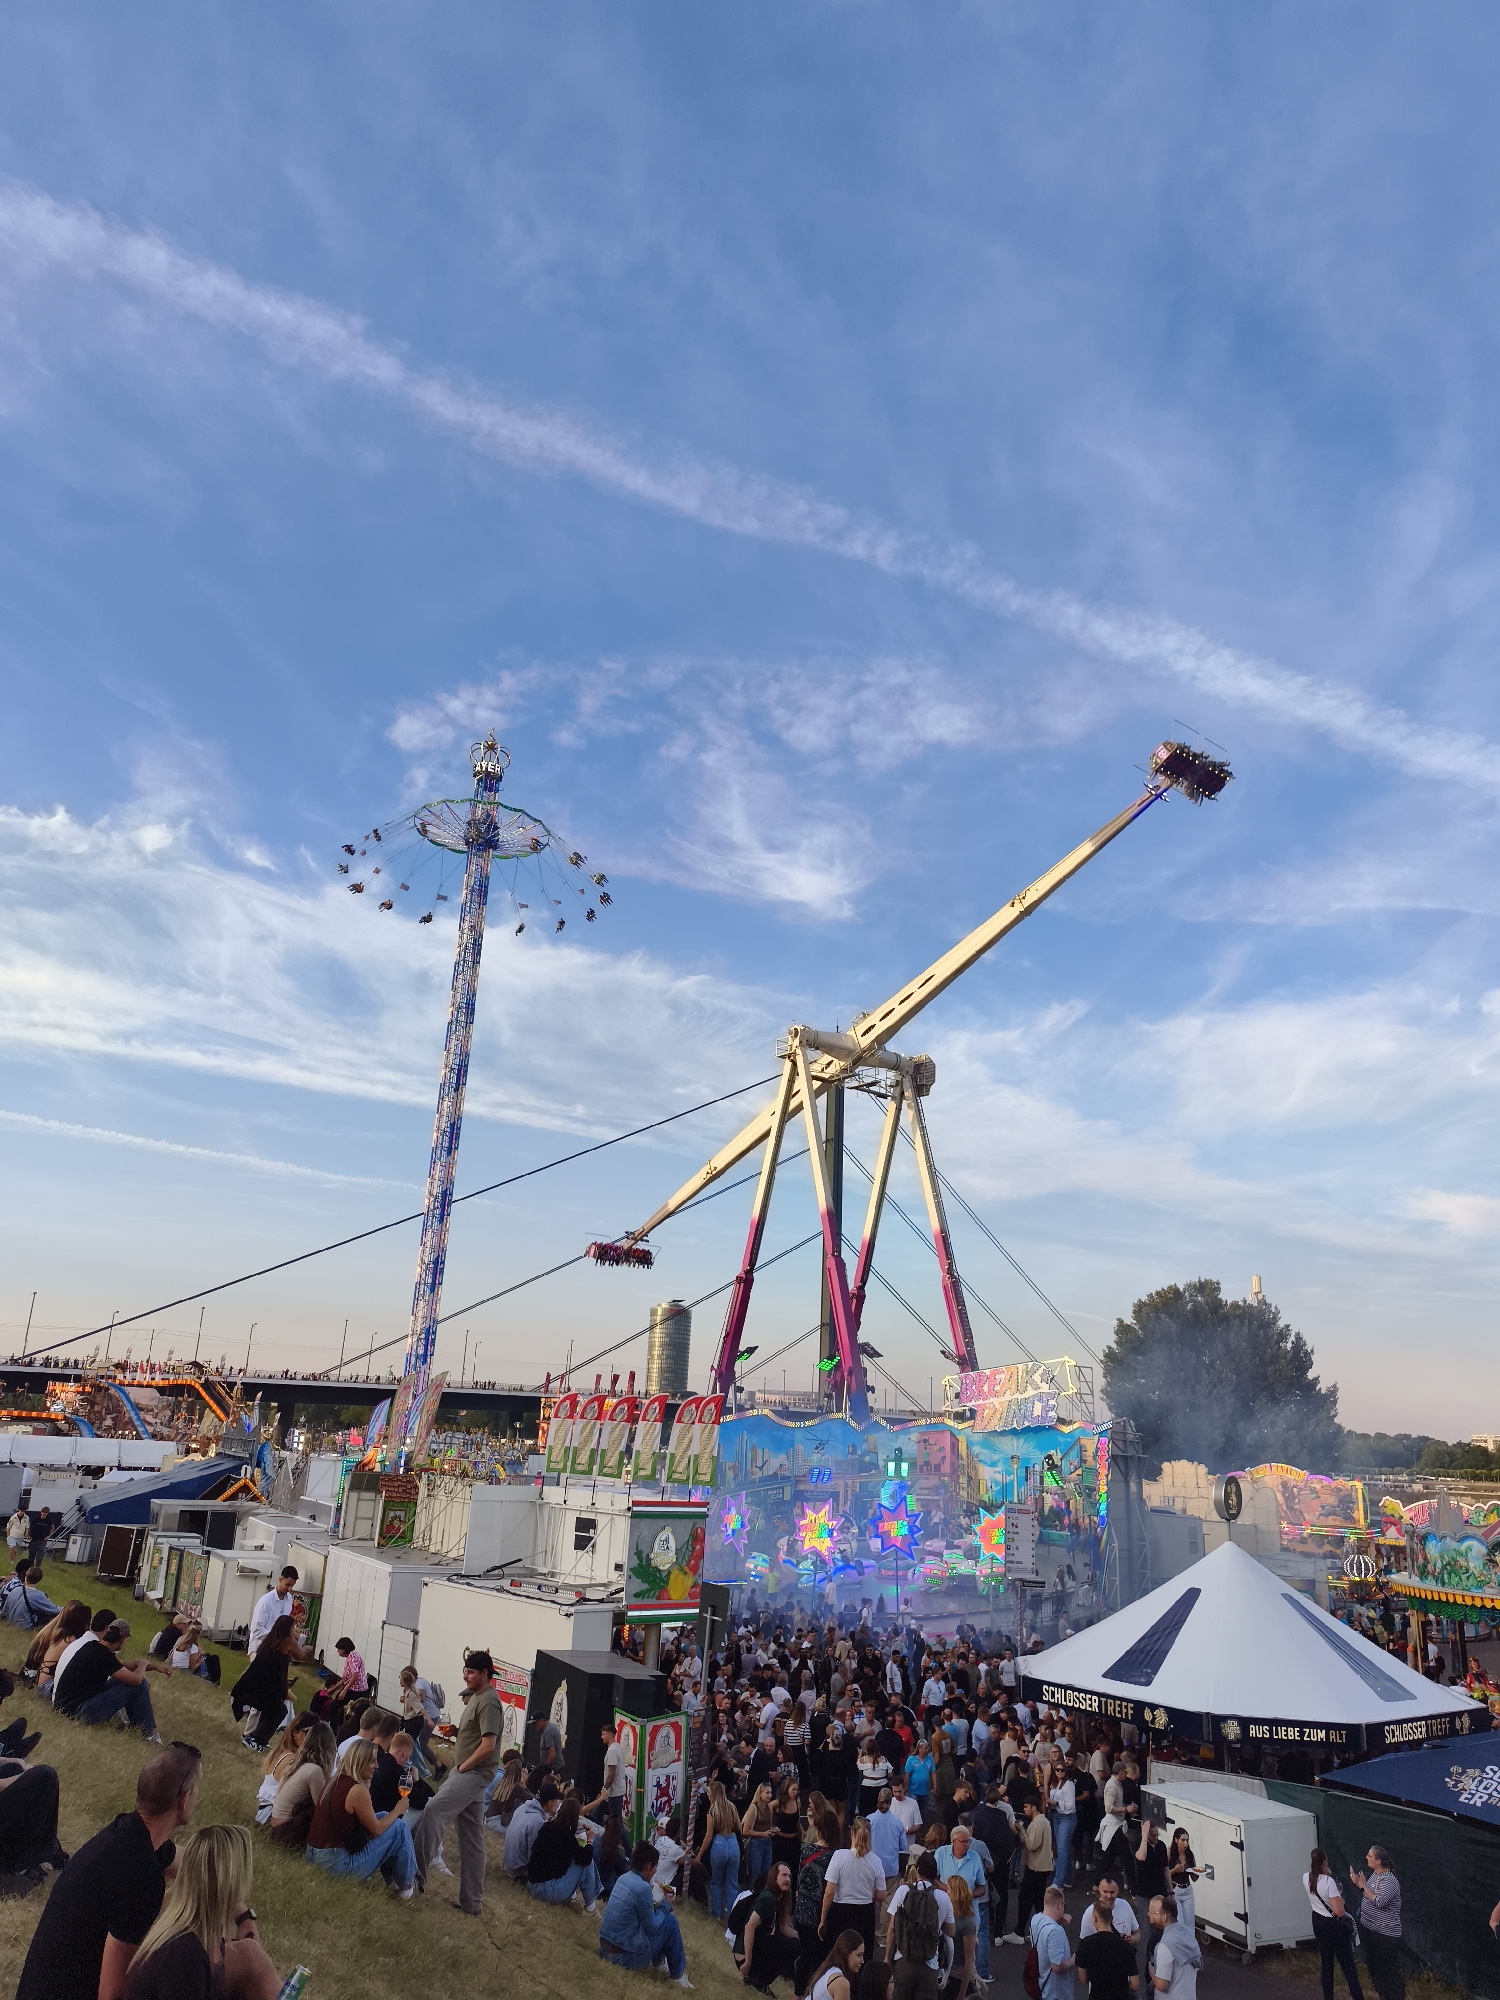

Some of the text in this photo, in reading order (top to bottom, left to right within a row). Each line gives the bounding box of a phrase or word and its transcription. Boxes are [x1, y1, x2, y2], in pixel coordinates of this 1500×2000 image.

[957, 1363, 1042, 1407] BREAK
[972, 1389, 1059, 1433] DANCE
[1100, 1697, 1134, 1720] TREFF
[1249, 1724, 1347, 1743] AUS LIEBE ZUM ALT
[1427, 1717, 1450, 1737] TREFF
[1459, 1791, 1489, 1807] ER
